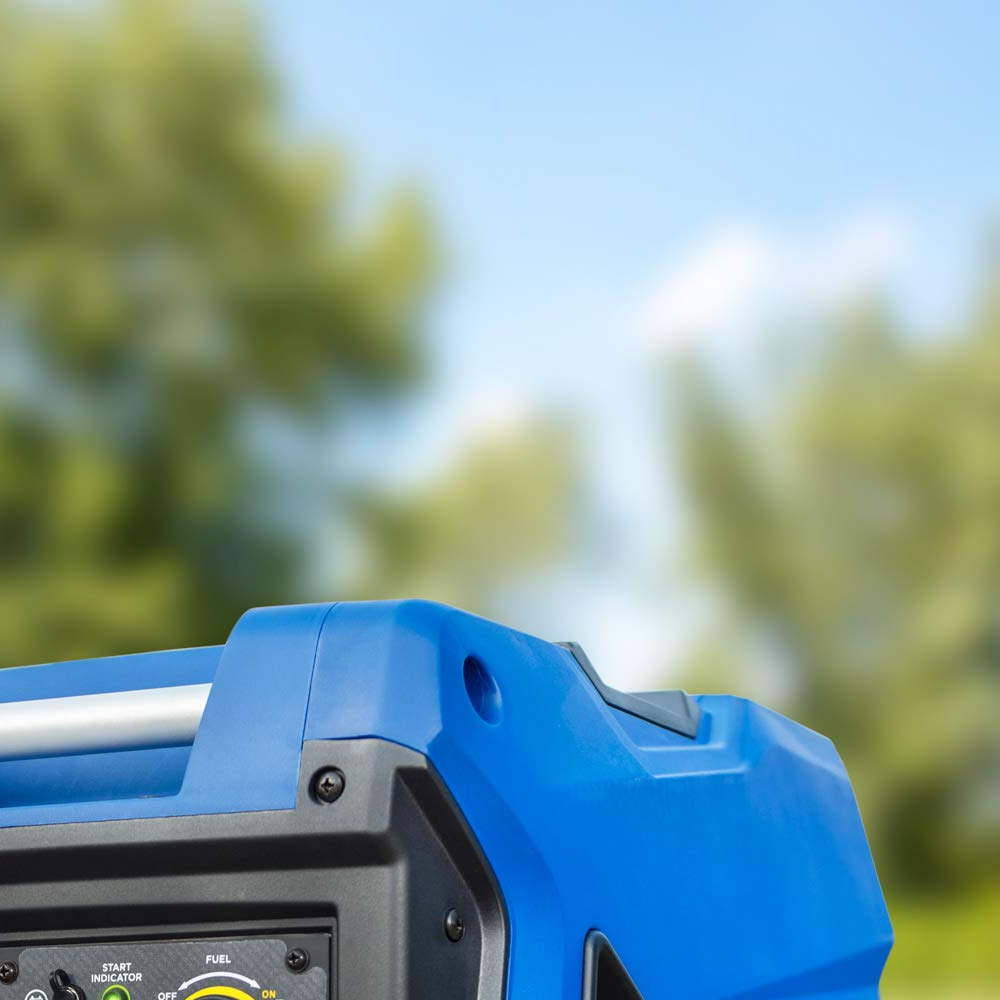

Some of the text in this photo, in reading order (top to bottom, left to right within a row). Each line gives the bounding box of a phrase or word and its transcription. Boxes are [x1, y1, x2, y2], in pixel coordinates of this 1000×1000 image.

[206, 954, 231, 964] FUEL
[102, 963, 131, 972] START
[91, 973, 142, 983] INDICATOR
[262, 990, 276, 999] ON
